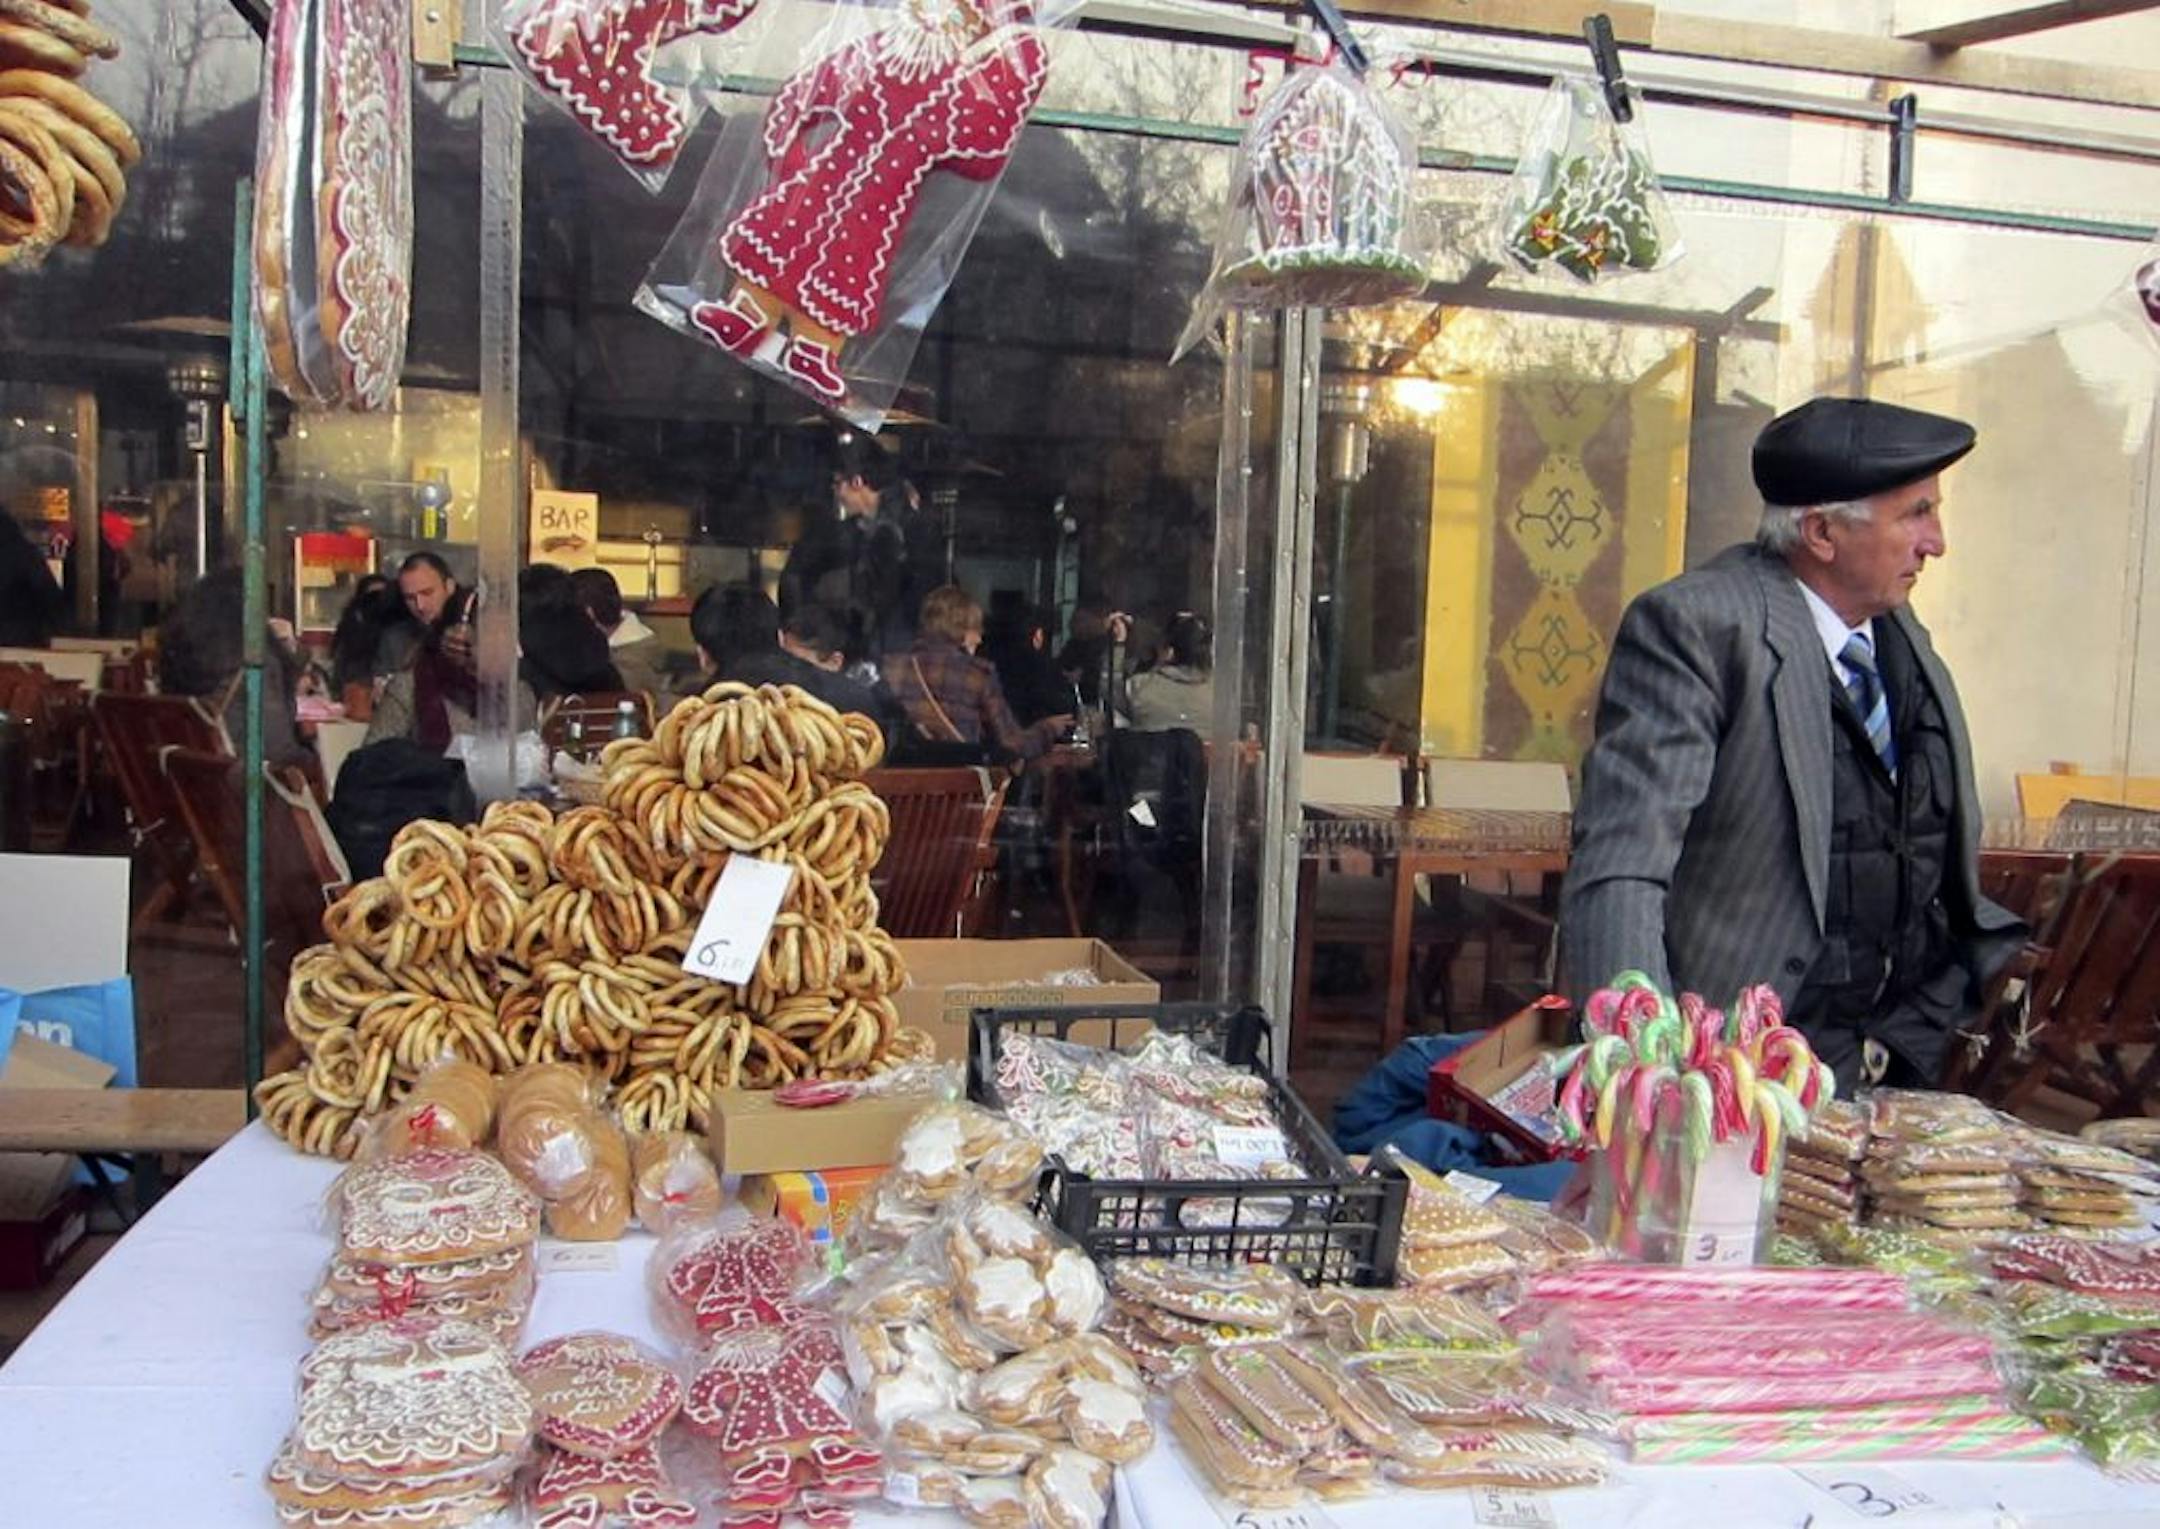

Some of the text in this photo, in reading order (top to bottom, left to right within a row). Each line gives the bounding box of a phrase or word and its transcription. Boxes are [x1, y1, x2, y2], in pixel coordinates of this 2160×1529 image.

[540, 505, 592, 532] BAR
[697, 939, 731, 967] 6
[1695, 1233, 1718, 1261] 3
[1829, 1481, 1898, 1517] 3
